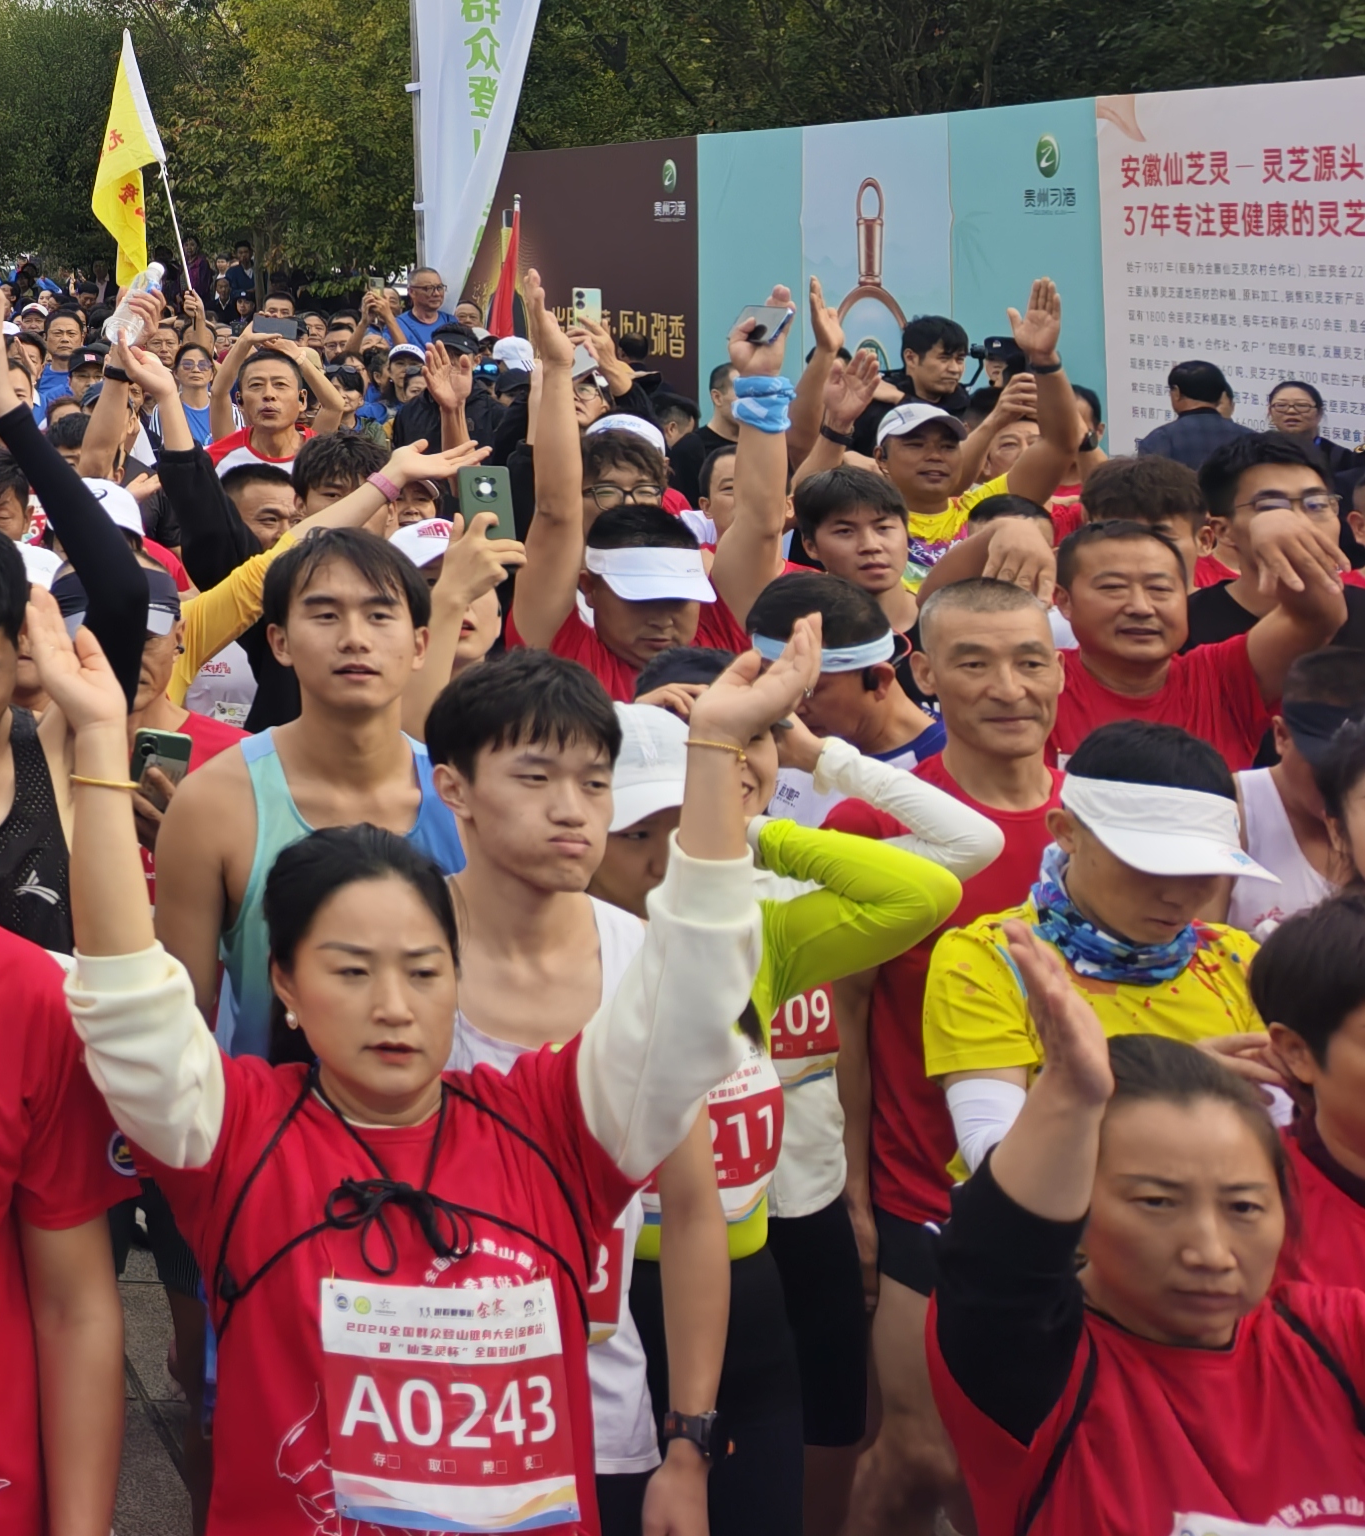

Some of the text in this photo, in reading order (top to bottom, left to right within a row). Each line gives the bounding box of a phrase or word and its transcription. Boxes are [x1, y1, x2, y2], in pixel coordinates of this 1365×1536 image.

[1121, 151, 1230, 188] 安徽仙芝灵
[1262, 143, 1365, 184] 灵芝源头
[1024, 187, 1076, 208] 贵州习酒
[1123, 199, 1365, 237] 37年专注更健康的灵芝
[476, 1298, 506, 1319] 金寨
[475, 1343, 527, 1358] 全国登山赛
[340, 1374, 557, 1448] A0243
